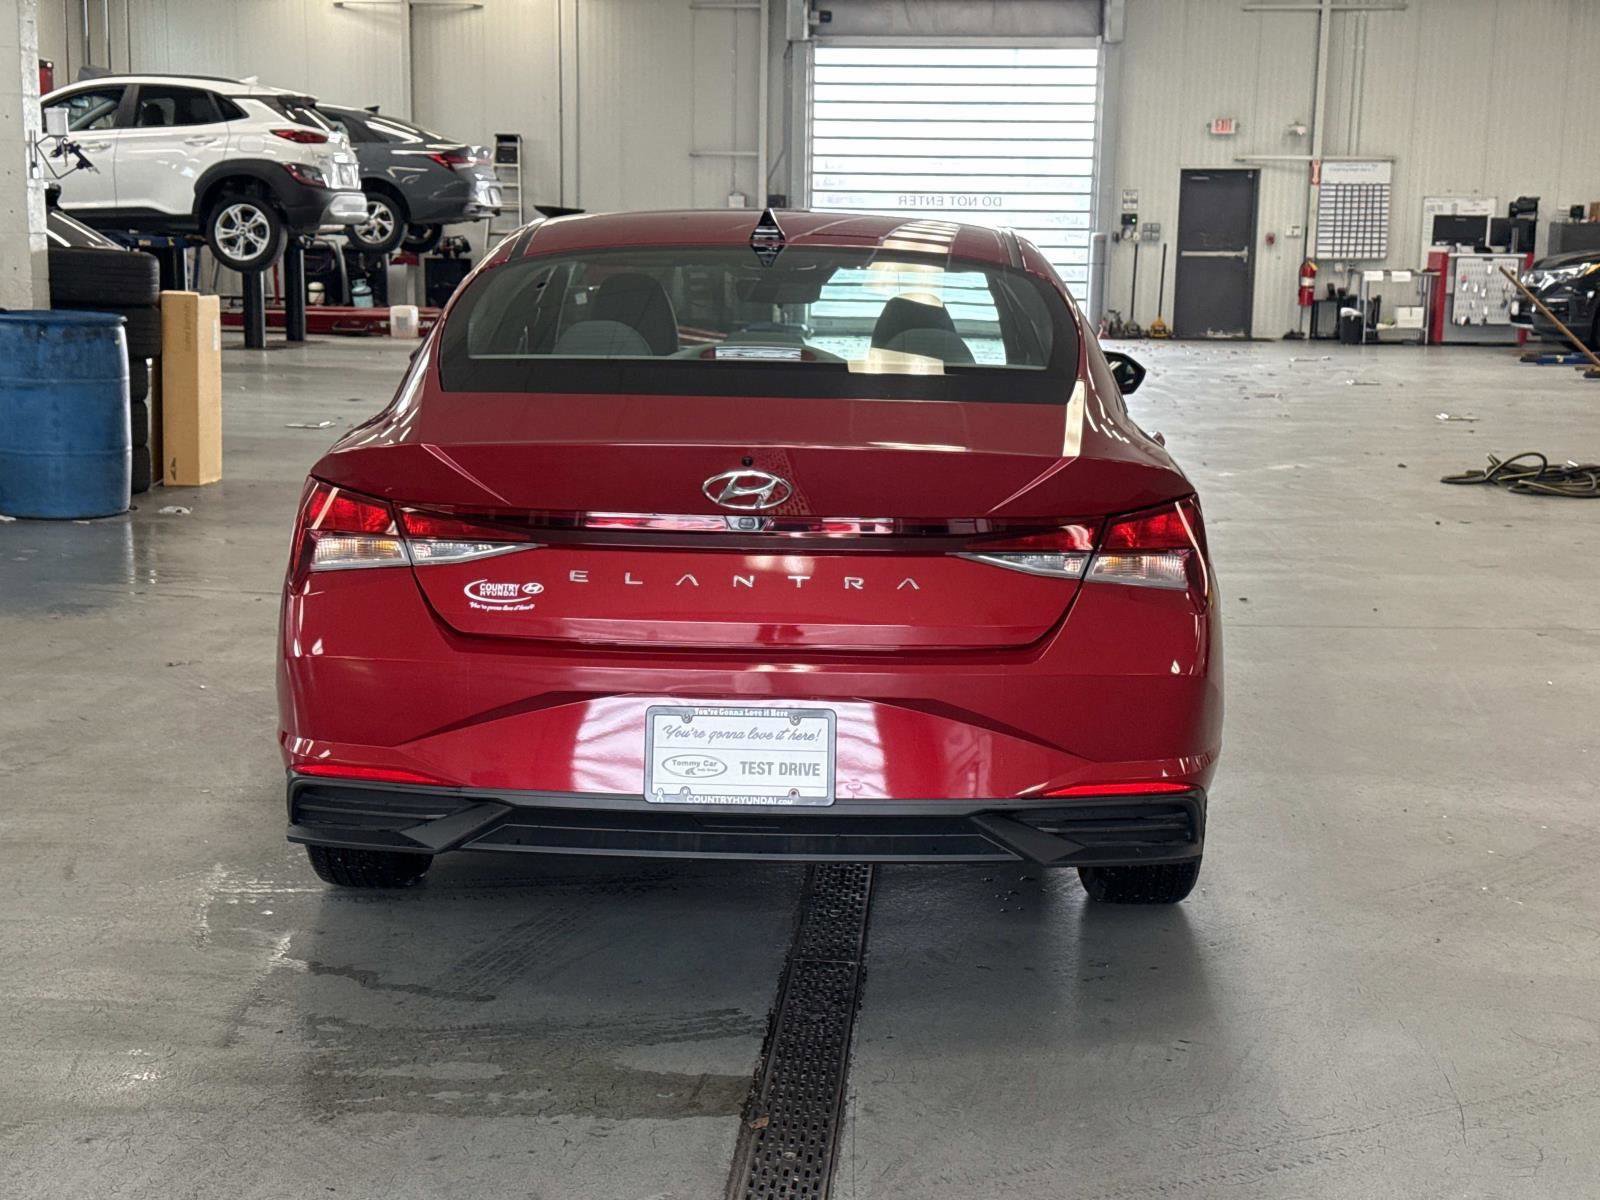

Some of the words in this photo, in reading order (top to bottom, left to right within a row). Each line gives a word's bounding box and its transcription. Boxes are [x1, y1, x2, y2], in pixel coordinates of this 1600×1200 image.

[569, 570, 920, 590] ELANTRA
[480, 583, 520, 591] COUNTRY
[719, 708, 744, 716] Gonna
[663, 724, 706, 740] You're
[708, 728, 745, 744] gonna
[747, 726, 774, 741] love
[775, 728, 787, 741] it
[787, 728, 822, 742] here!
[672, 759, 701, 768] Tommy
[740, 761, 775, 776] TEST
[778, 762, 821, 777] DRIVE
